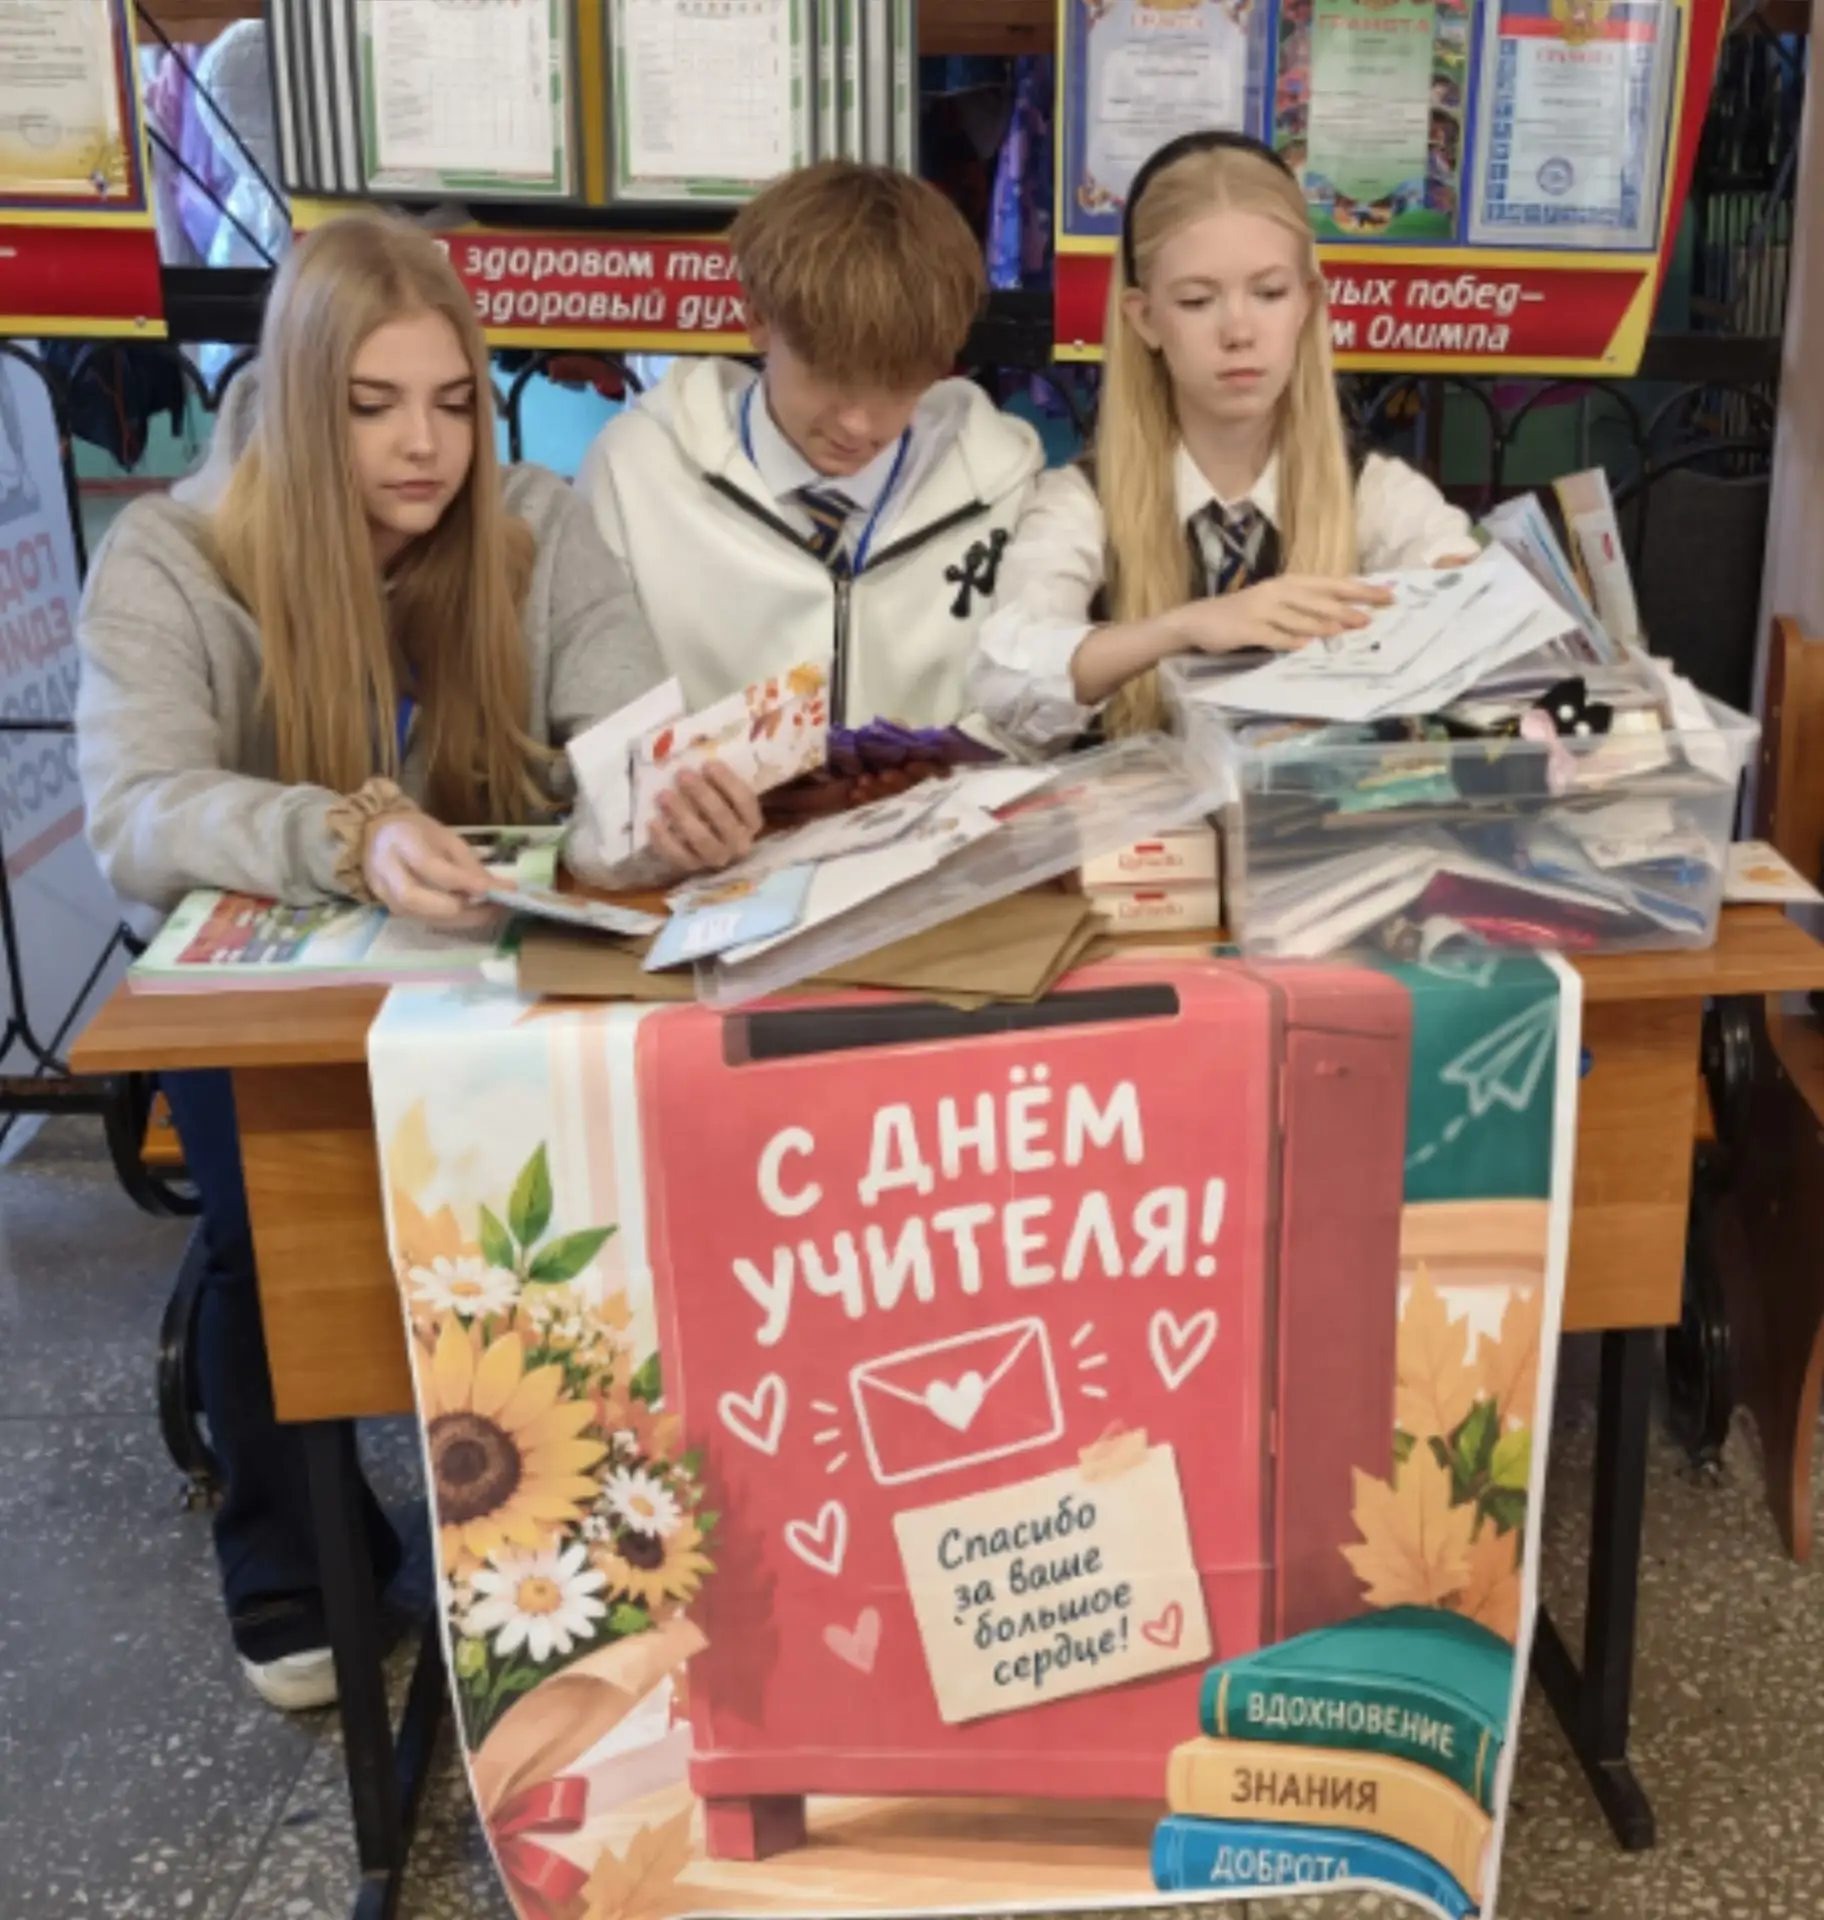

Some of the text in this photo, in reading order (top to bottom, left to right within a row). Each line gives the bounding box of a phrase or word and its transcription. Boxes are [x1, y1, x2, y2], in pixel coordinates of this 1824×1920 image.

[464, 246, 654, 282] здоровом
[475, 289, 747, 330] здоровый дух
[1366, 314, 1512, 353] Олимпа
[757, 1063, 1145, 1217] С ДНЁМ
[732, 1177, 1227, 1346] УЧИТЕЛЯ!
[937, 1493, 1097, 1570] Спасибо
[954, 1546, 1103, 1612] за ваше
[973, 1581, 1132, 1650] большое
[993, 1614, 1129, 1690] сердце!
[1246, 1691, 1456, 1760] ВДОХНОВЕНИЕ
[1231, 1766, 1379, 1814] ЗНАНИЯ
[1209, 1845, 1350, 1886] ДОБРОТА
